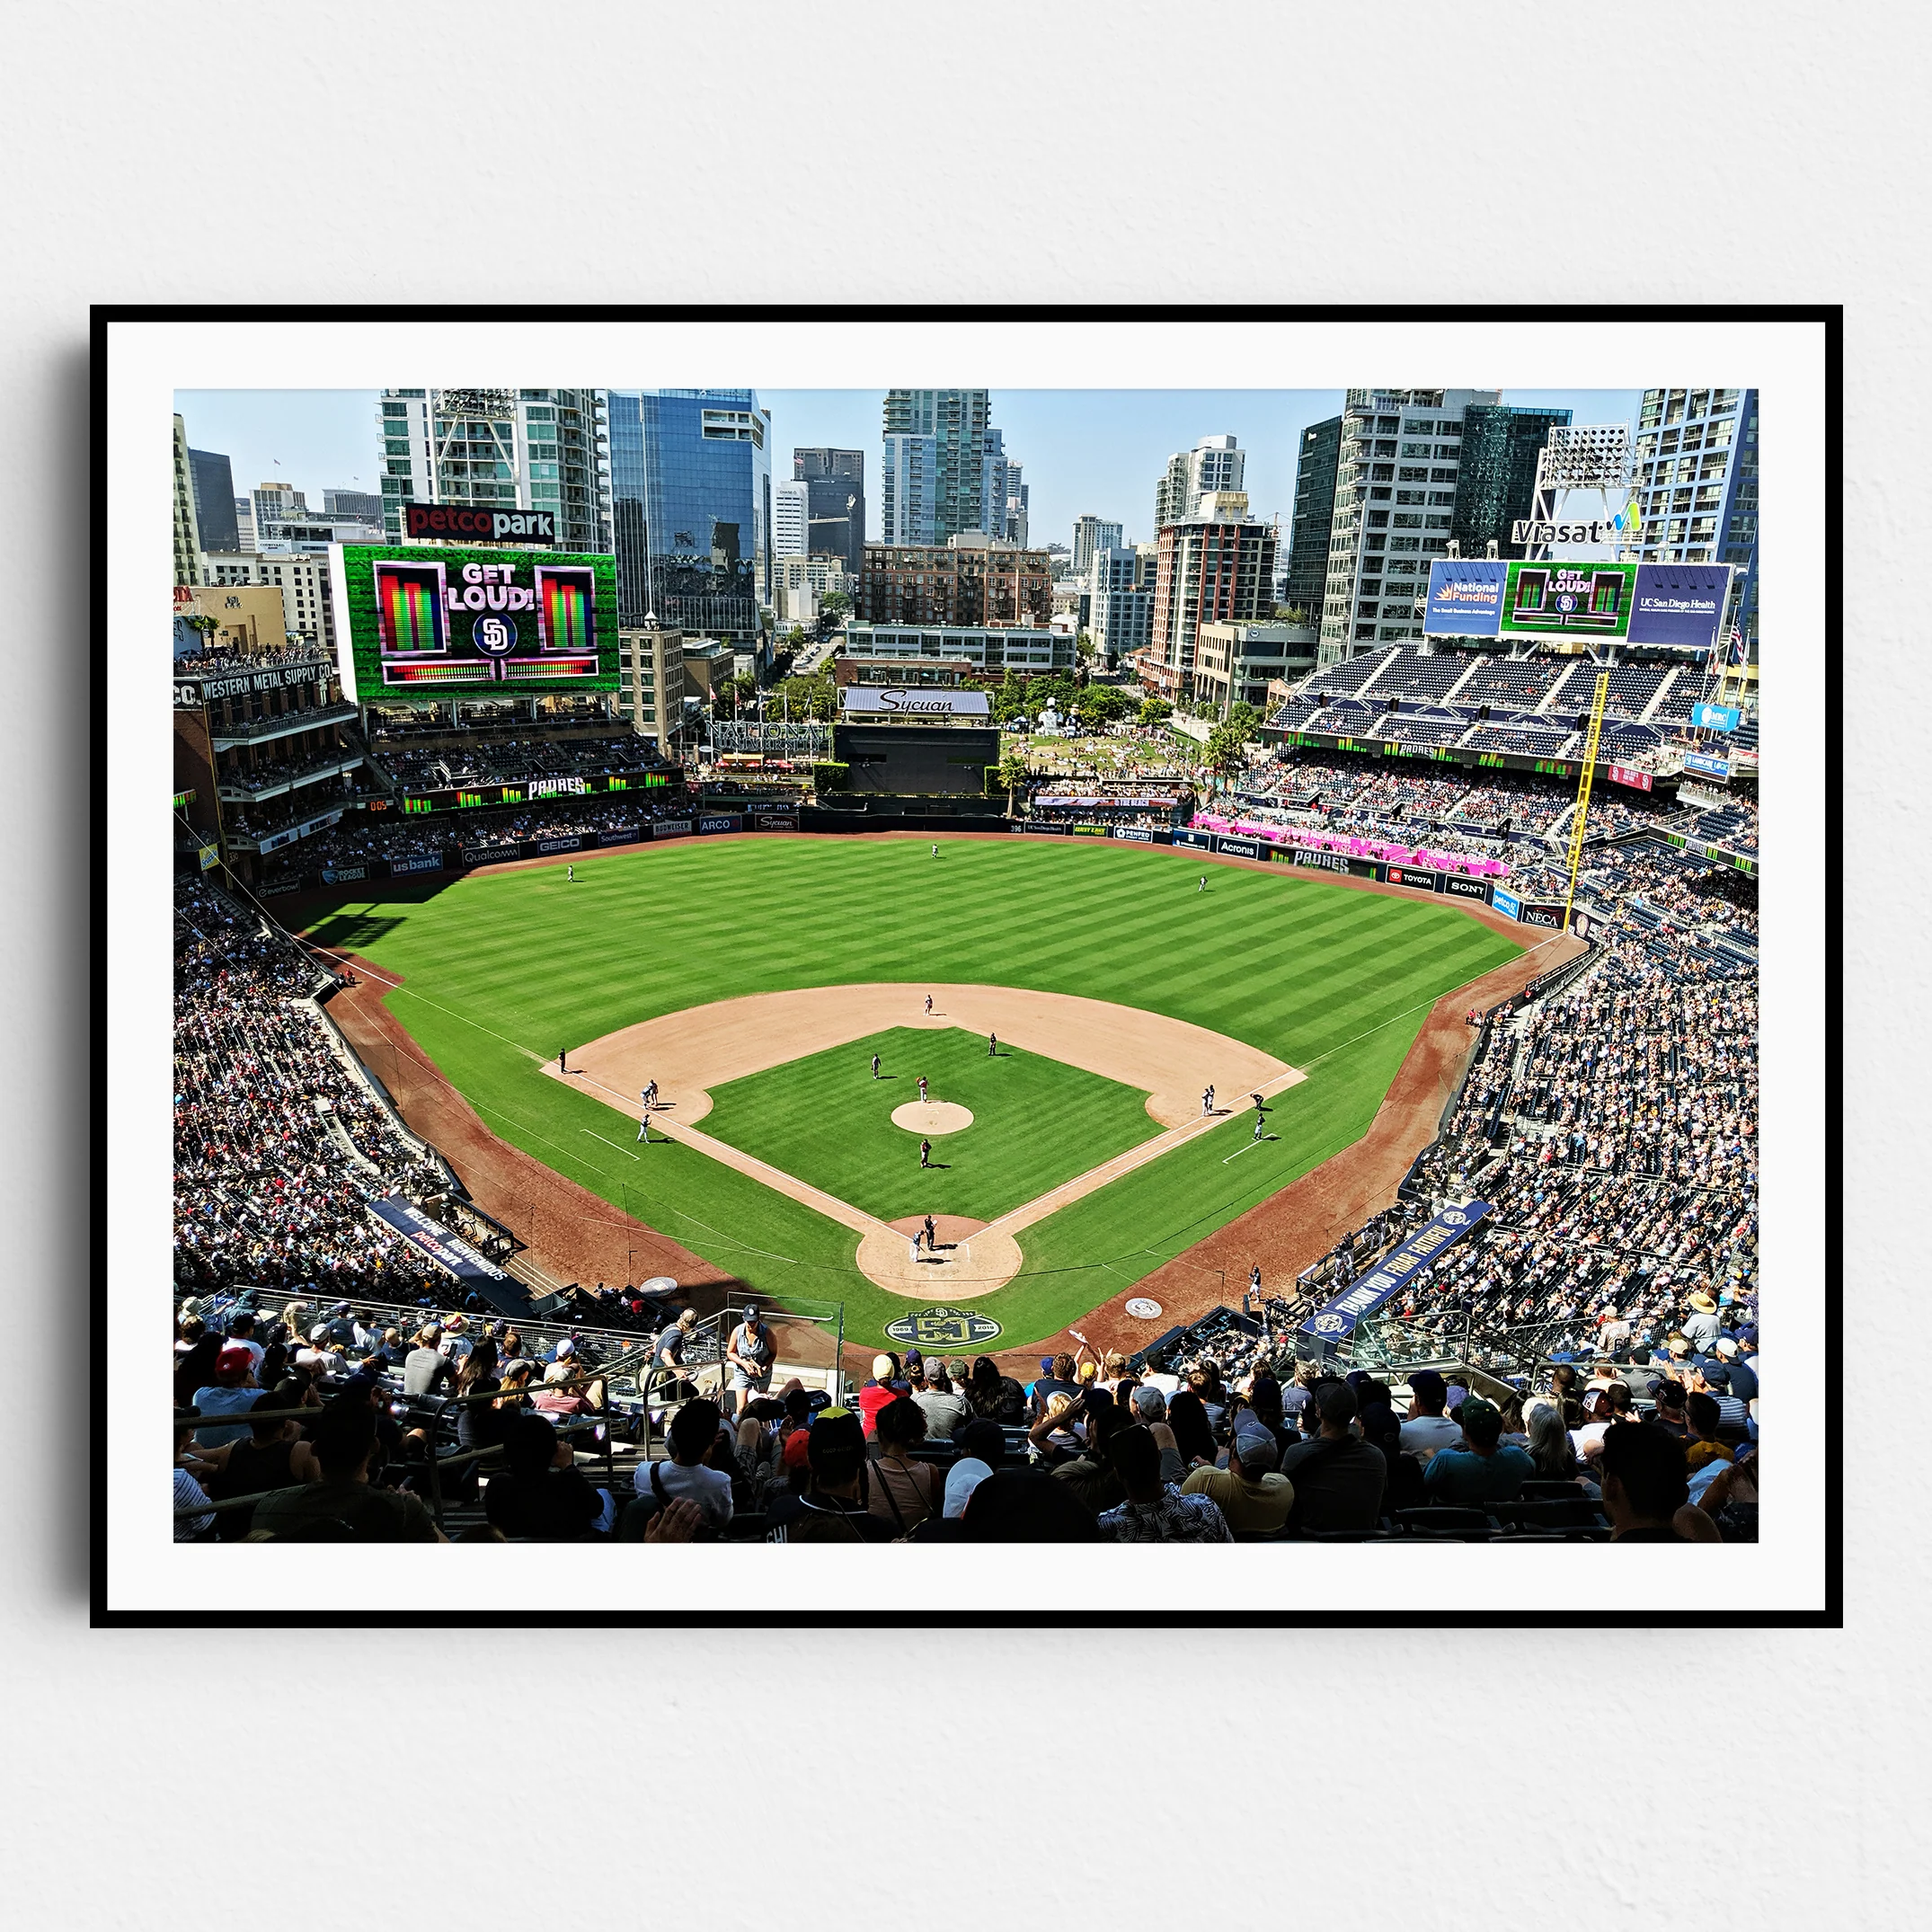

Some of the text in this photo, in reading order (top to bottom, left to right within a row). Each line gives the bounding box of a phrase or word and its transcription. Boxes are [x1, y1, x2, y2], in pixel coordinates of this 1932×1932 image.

[1517, 520, 1600, 543] Viasat
[462, 563, 516, 584] GET
[1557, 569, 1583, 580] GET
[1454, 582, 1500, 593] National
[448, 586, 535, 611] LOUD!
[1452, 592, 1498, 604] Funding
[1640, 598, 1715, 609] UC San Diego Health
[203, 663, 334, 700] WESTERN METAL SUPPLY CO.
[879, 689, 955, 717] Sycuan
[705, 721, 832, 740] NATIONAL
[715, 736, 823, 751] UNIVERSITY
[1399, 743, 1435, 760] PADRES
[528, 776, 585, 801] PADRES
[655, 822, 689, 832] BUDWEISER
[701, 820, 731, 830] ARCO
[760, 816, 793, 829] Sycuan
[1011, 825, 1022, 833] 396
[601, 832, 633, 842] Southwest
[1126, 829, 1150, 837] PENFED
[539, 837, 581, 852] GEICO
[1220, 841, 1254, 855] Acronis
[465, 848, 518, 863] Qualcomm
[1294, 851, 1350, 874] PADRES
[1427, 850, 1449, 860] HOME
[1467, 856, 1487, 866] DECK
[339, 868, 365, 877] ROCKET
[339, 873, 366, 882] LEAGUE
[1404, 873, 1432, 885] TOYOTA
[1451, 882, 1484, 895] SONY
[1494, 894, 1511, 910] petco
[1526, 910, 1559, 927] NECA
[403, 1206, 509, 1281] WELCOME BIENVENIDOS
[1334, 1224, 1457, 1316] THANK YOU FRIAR FAITHFUL
